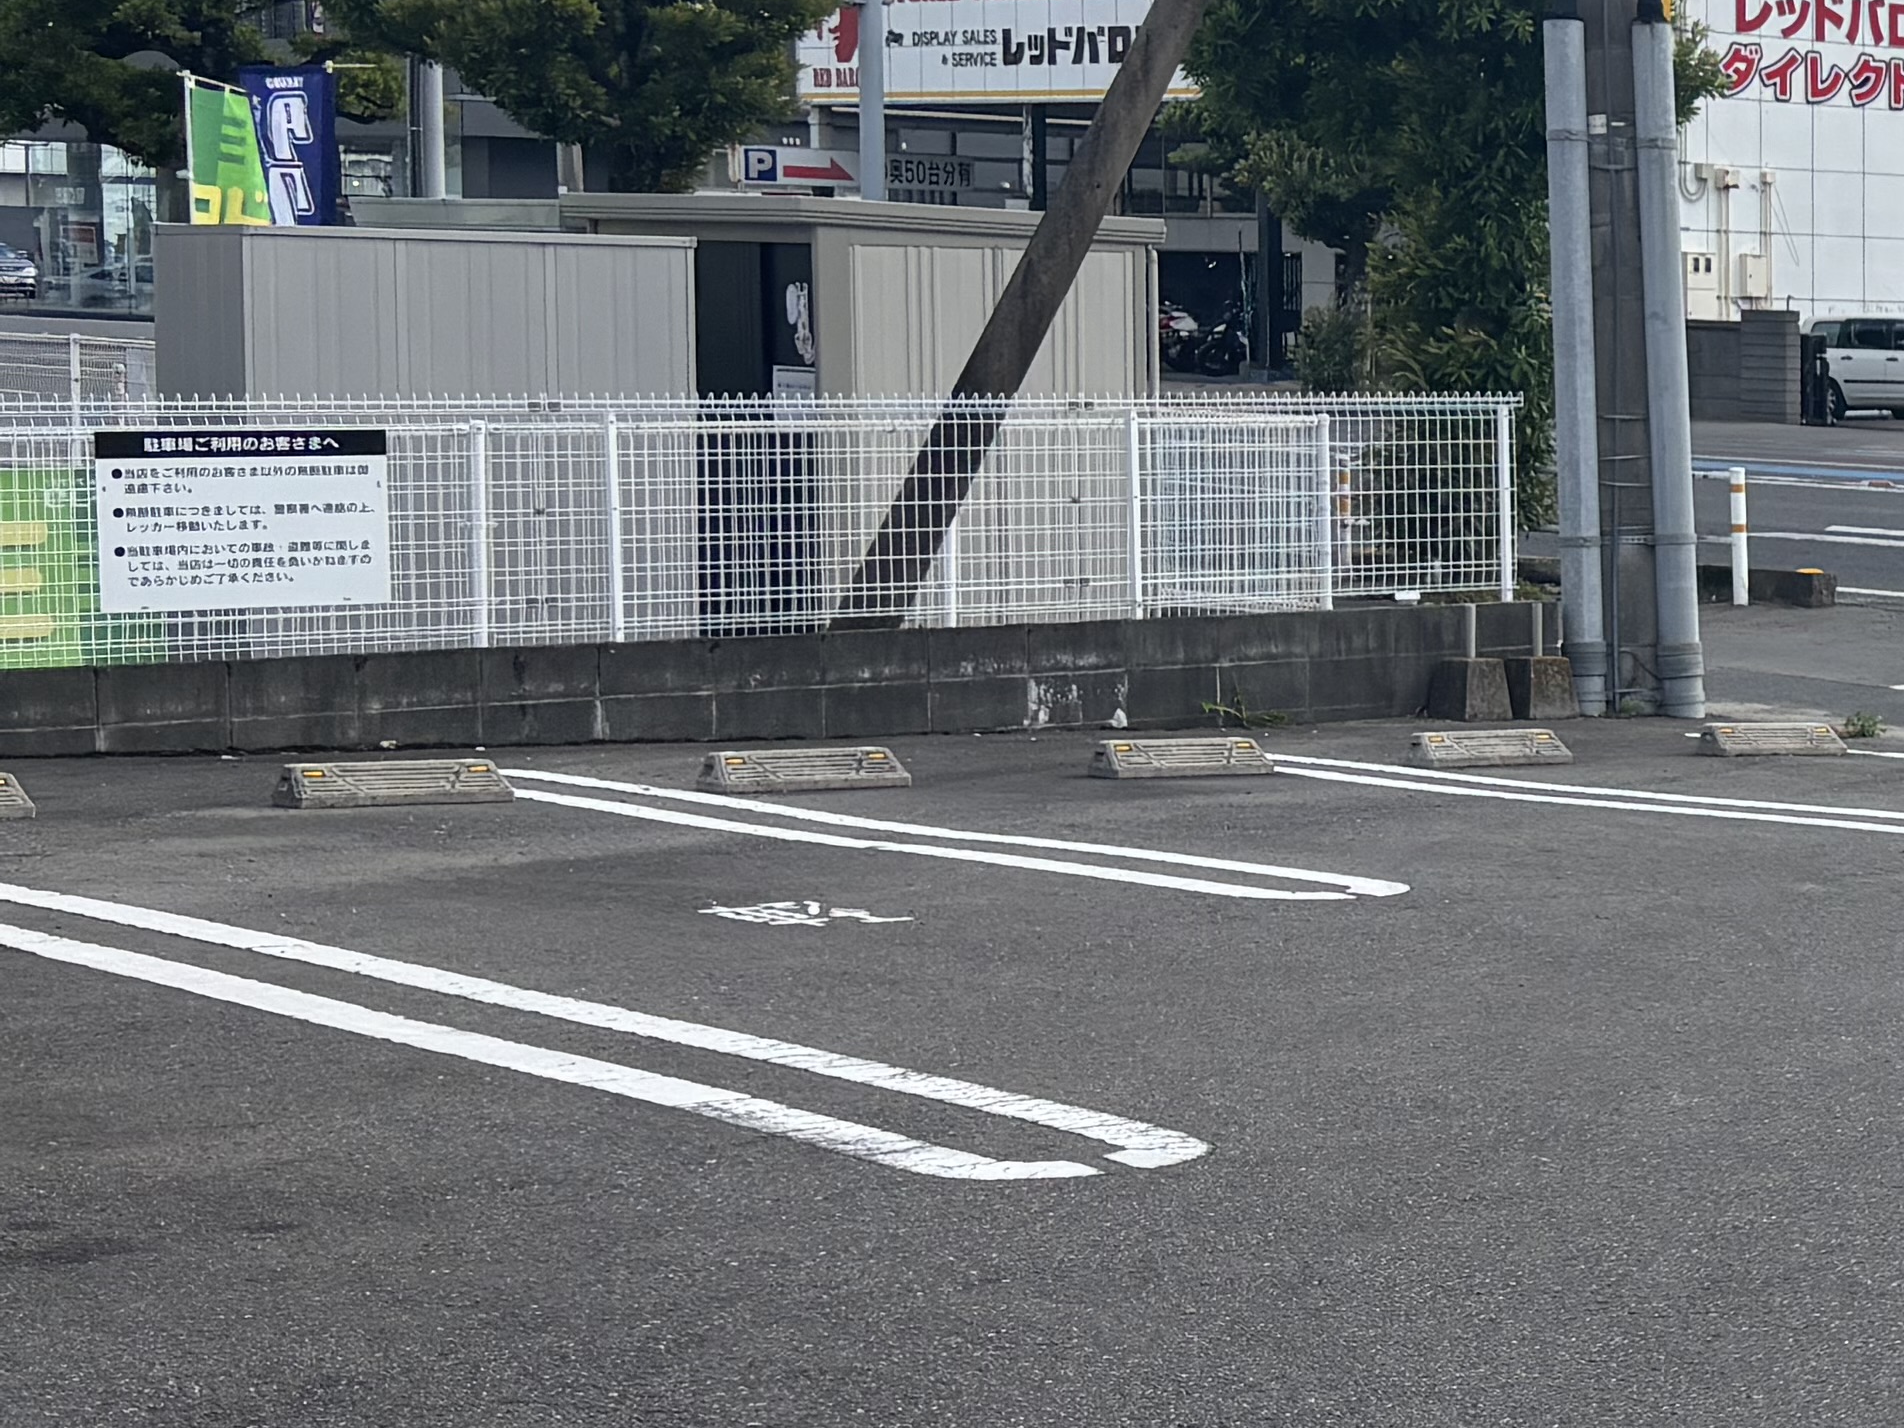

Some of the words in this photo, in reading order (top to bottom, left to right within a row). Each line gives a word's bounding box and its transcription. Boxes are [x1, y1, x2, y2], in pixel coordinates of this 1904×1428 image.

[912, 30, 957, 47] DISPLAY
[962, 29, 997, 45] SALES
[1002, 25, 1141, 66] レッドバロ
[951, 51, 997, 68] SERVICE
[813, 68, 832, 88] RED
[752, 151, 774, 179] P
[143, 436, 340, 453] 駐車場ご利用のお客さまへ
